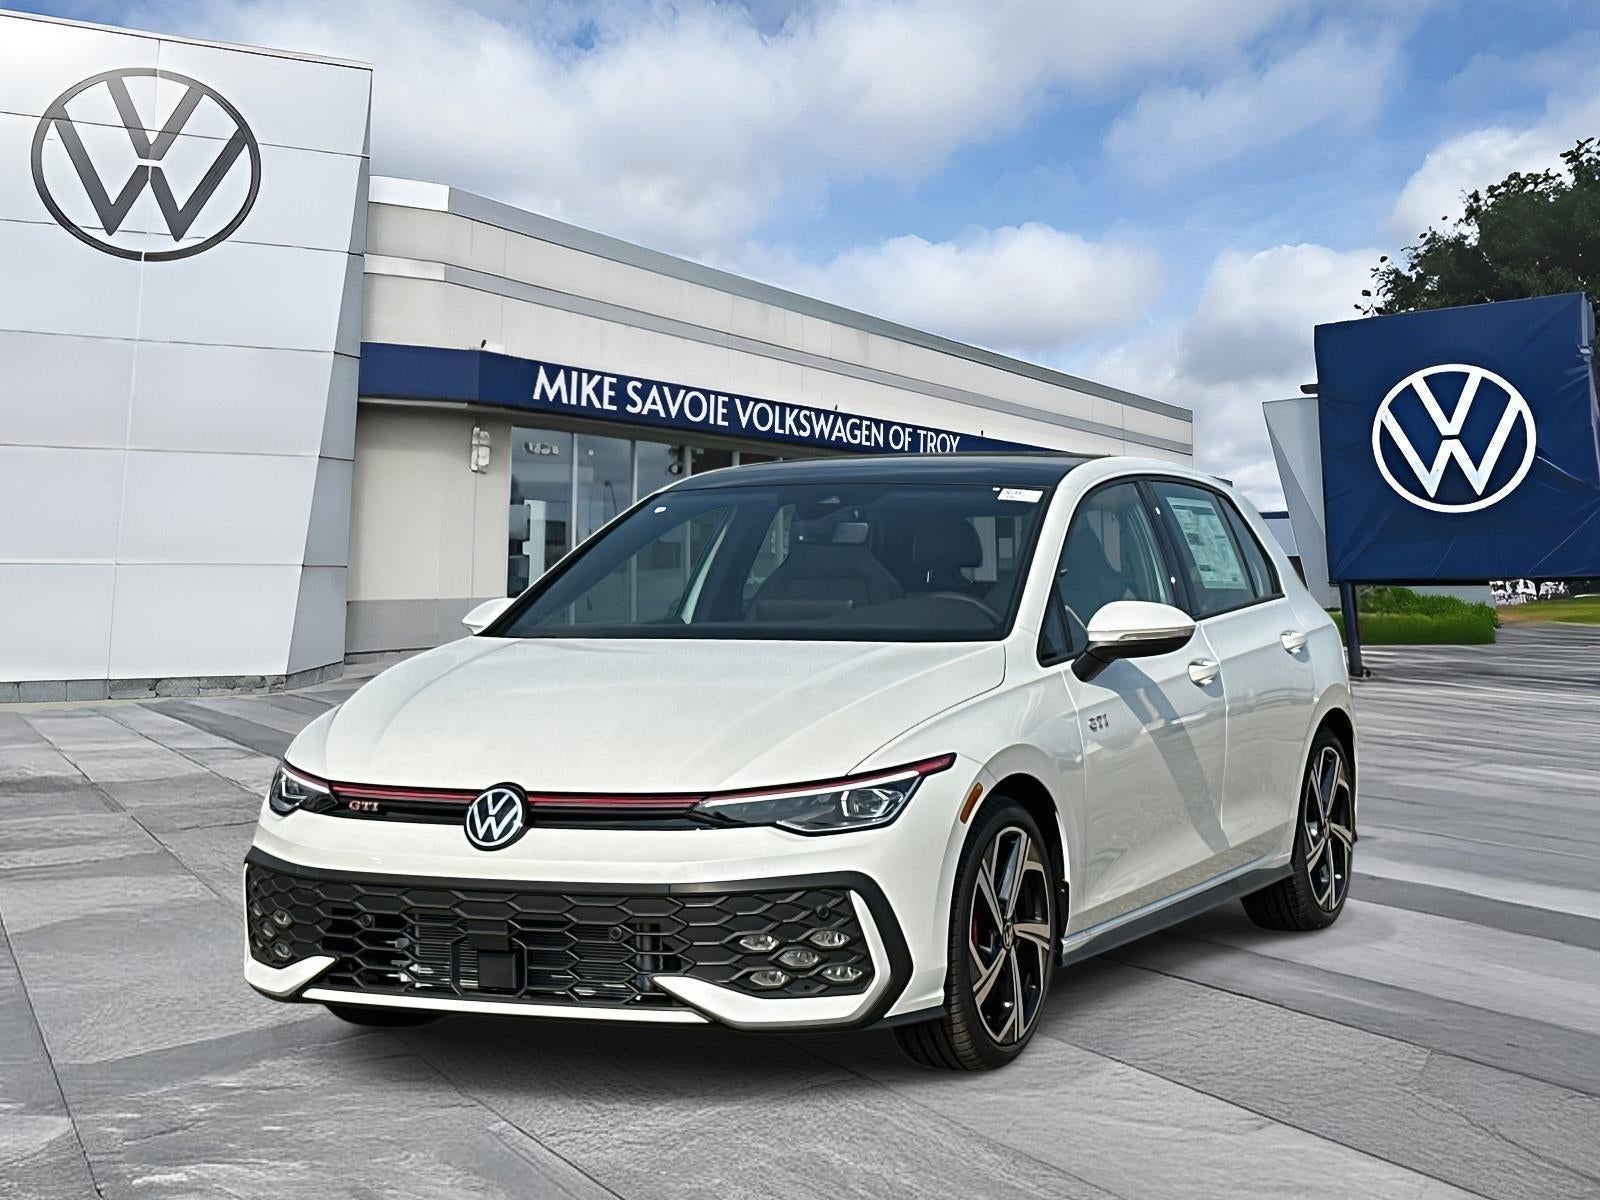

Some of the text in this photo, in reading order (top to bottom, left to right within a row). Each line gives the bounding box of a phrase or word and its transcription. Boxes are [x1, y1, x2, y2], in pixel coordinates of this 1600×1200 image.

[532, 365, 961, 454] MIKE SAVOIE VOLKSWAGEN OF TROY
[1088, 713, 1109, 732] GTI
[348, 800, 380, 812] GTI
